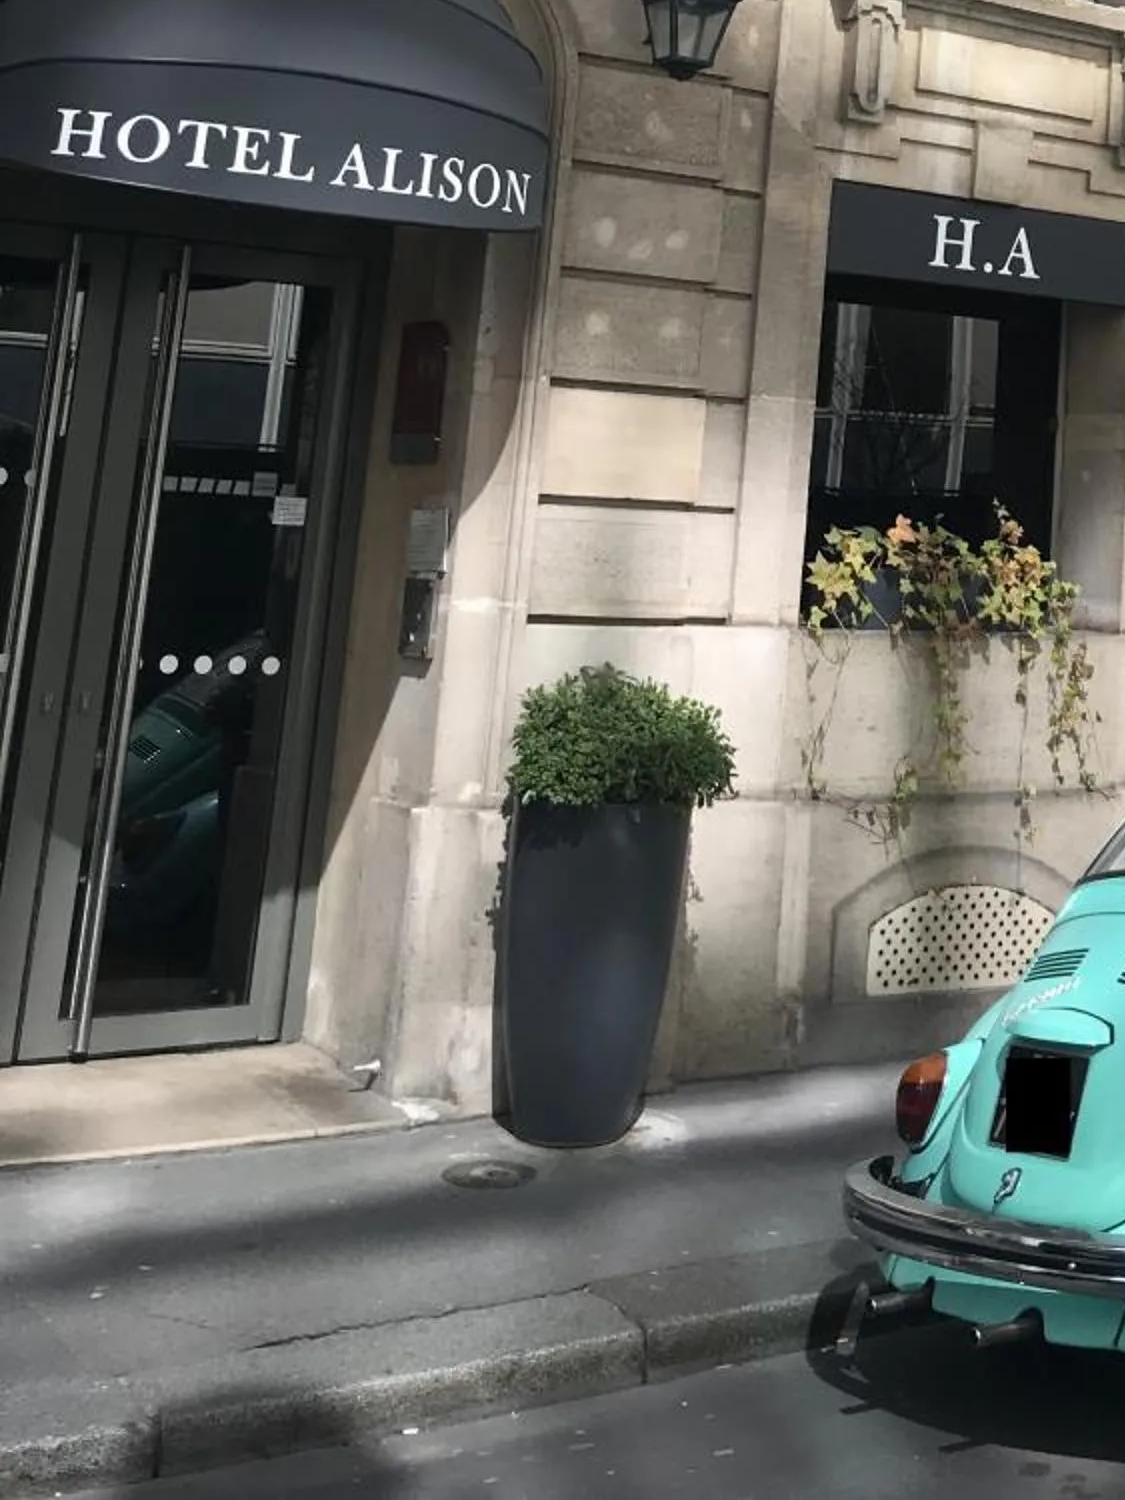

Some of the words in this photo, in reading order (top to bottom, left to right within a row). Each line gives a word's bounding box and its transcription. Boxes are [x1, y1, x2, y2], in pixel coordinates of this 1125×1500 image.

[50, 108, 315, 183] HOTEL
[329, 142, 532, 216] ALISON
[928, 214, 1041, 279] H.A
